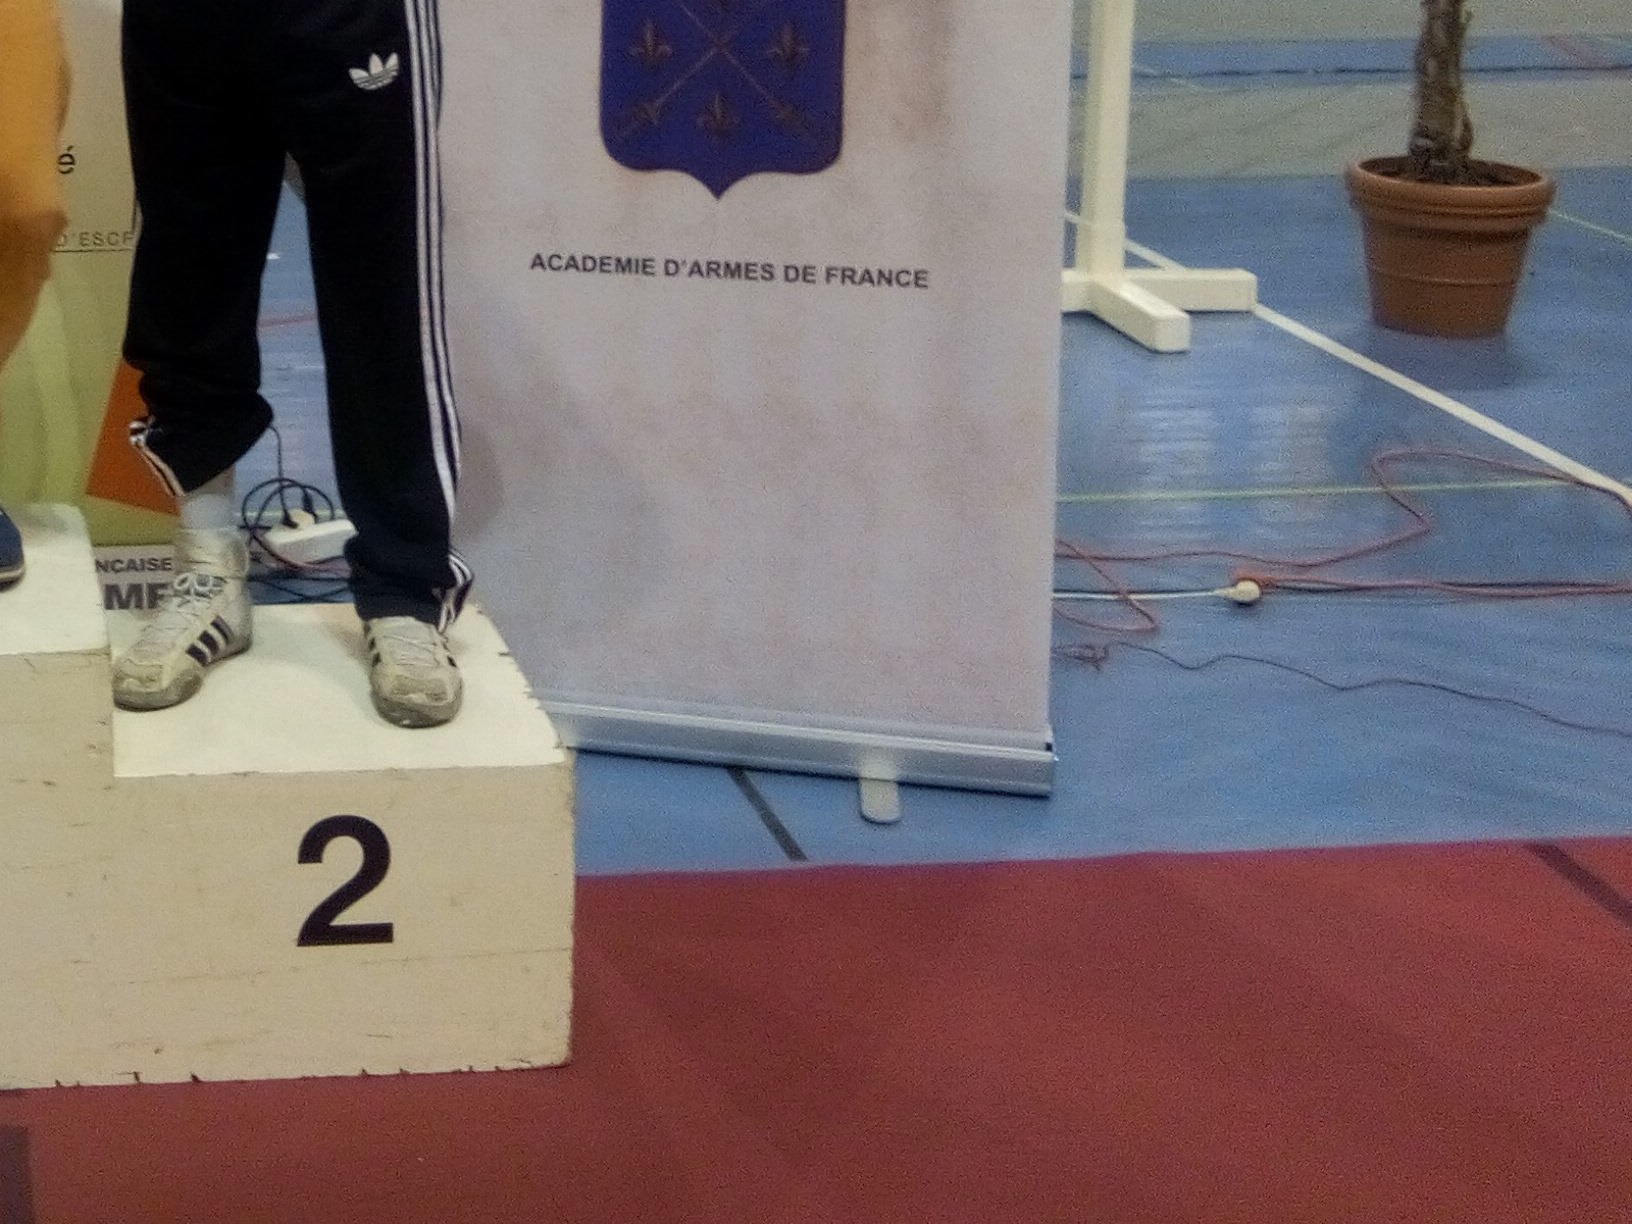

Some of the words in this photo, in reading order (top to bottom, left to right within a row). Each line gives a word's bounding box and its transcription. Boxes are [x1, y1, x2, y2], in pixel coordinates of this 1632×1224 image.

[529, 252, 656, 276] ACADEMIE
[663, 258, 775, 282] D'ARMES
[783, 264, 817, 284] DE
[824, 266, 929, 289] FRANCE
[296, 814, 394, 947] 2
